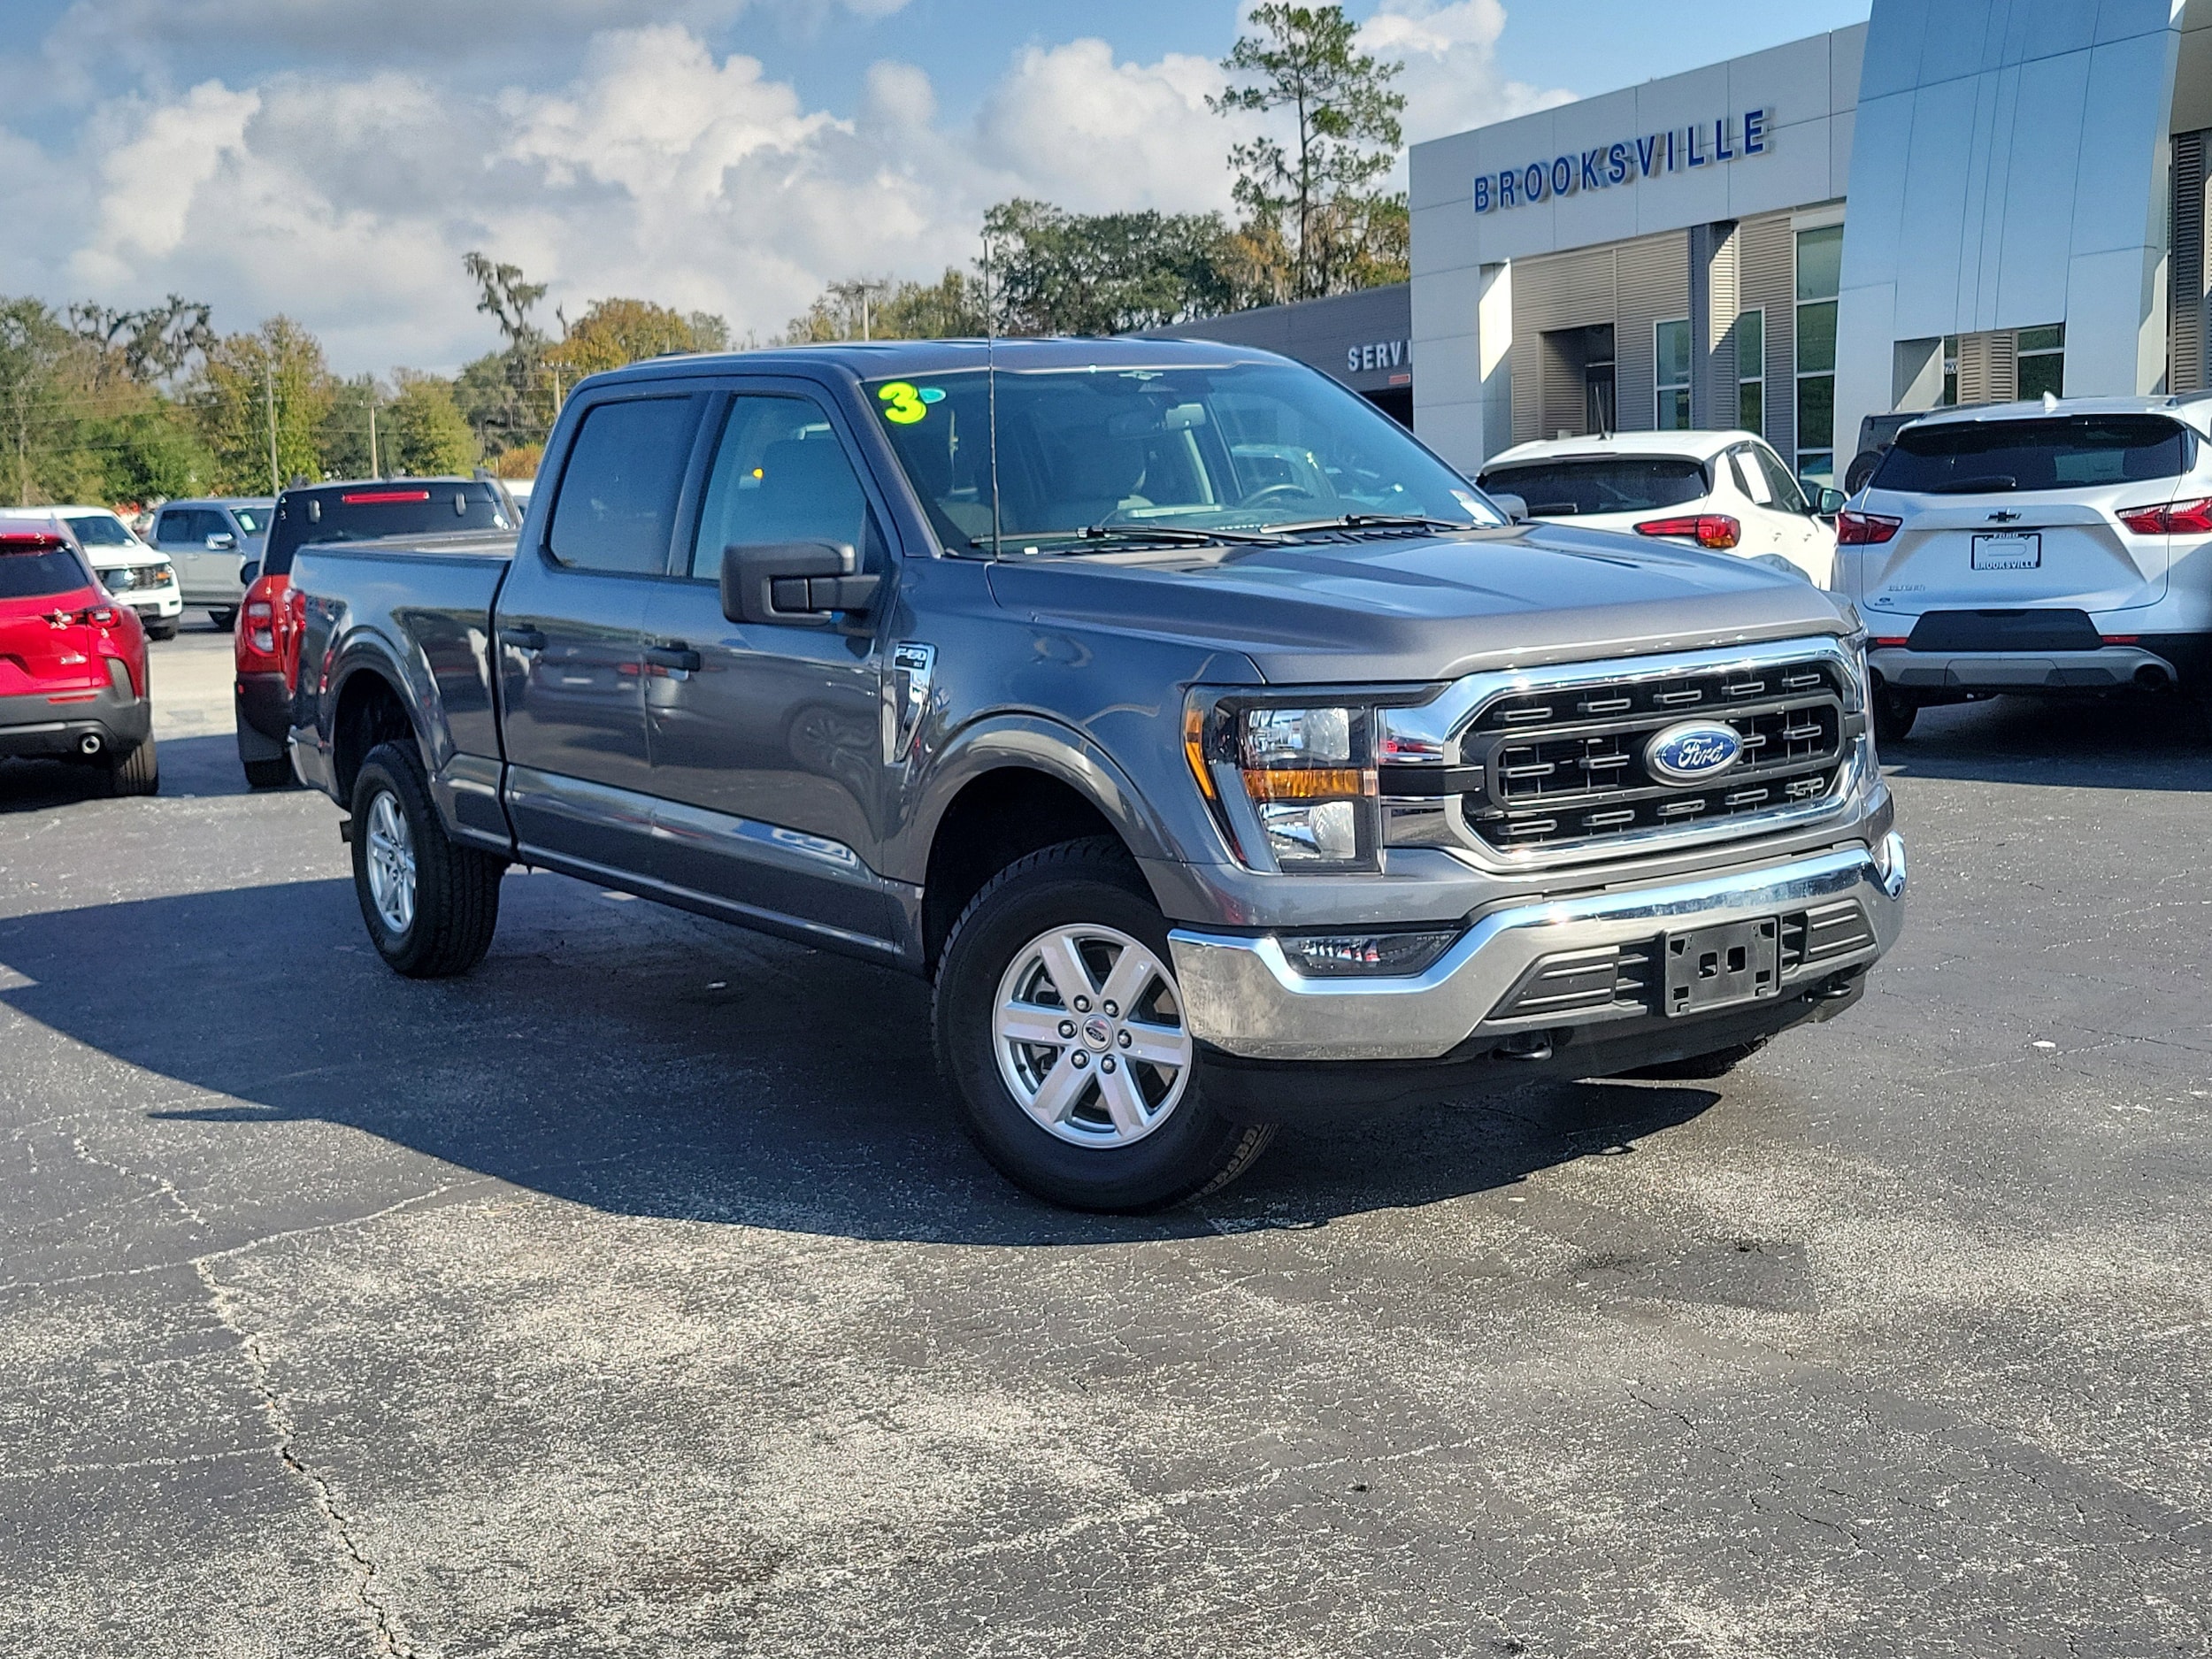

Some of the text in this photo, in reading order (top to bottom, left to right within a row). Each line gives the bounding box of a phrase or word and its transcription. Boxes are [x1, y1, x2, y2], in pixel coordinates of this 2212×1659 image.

[1473, 108, 1767, 214] BROOKSVILLE
[878, 381, 927, 424] 3
[1678, 736, 1724, 768] Ford
